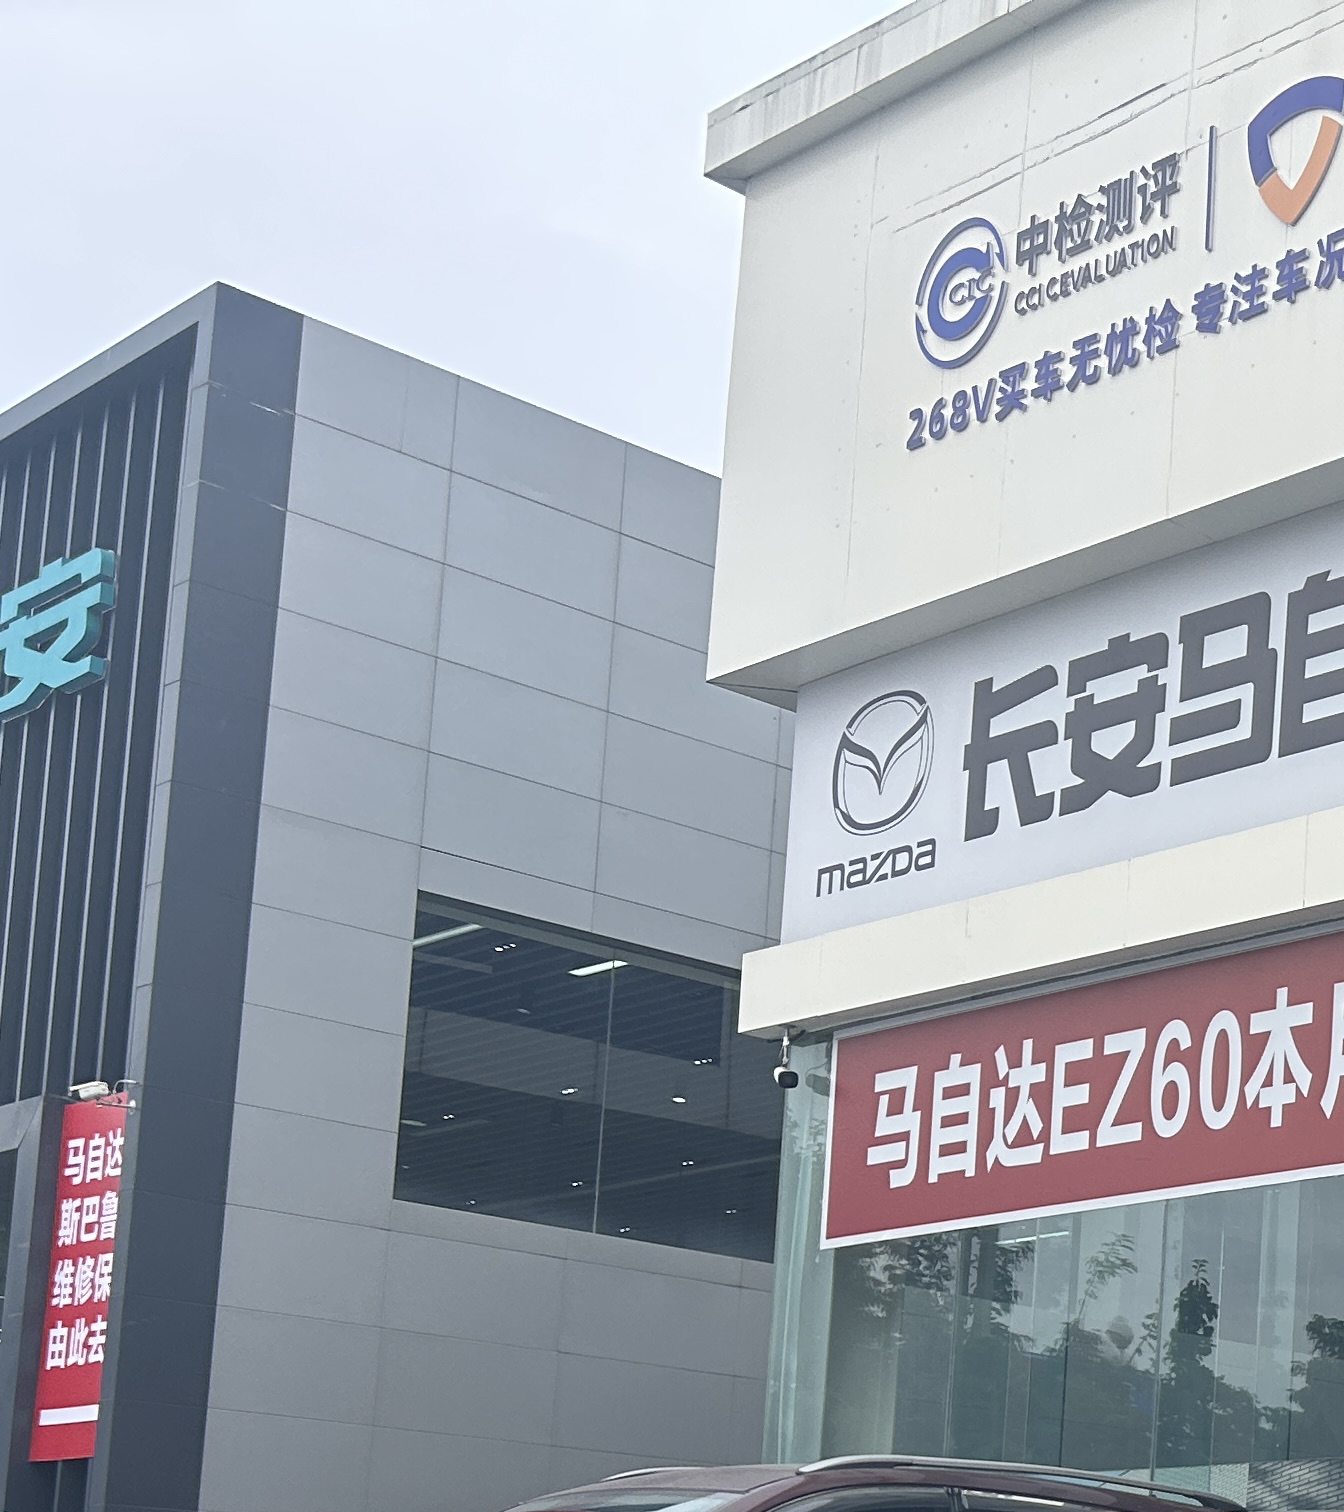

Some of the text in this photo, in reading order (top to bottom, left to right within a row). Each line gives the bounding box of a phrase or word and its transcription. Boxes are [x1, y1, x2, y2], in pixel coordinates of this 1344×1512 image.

[1014, 151, 1183, 277] 中检测评
[906, 298, 1182, 450] 268V买车无忧检
[63, 1127, 124, 1186] 马自达
[56, 1190, 119, 1247] 斯巴鲁
[45, 1314, 108, 1370] 由此去
